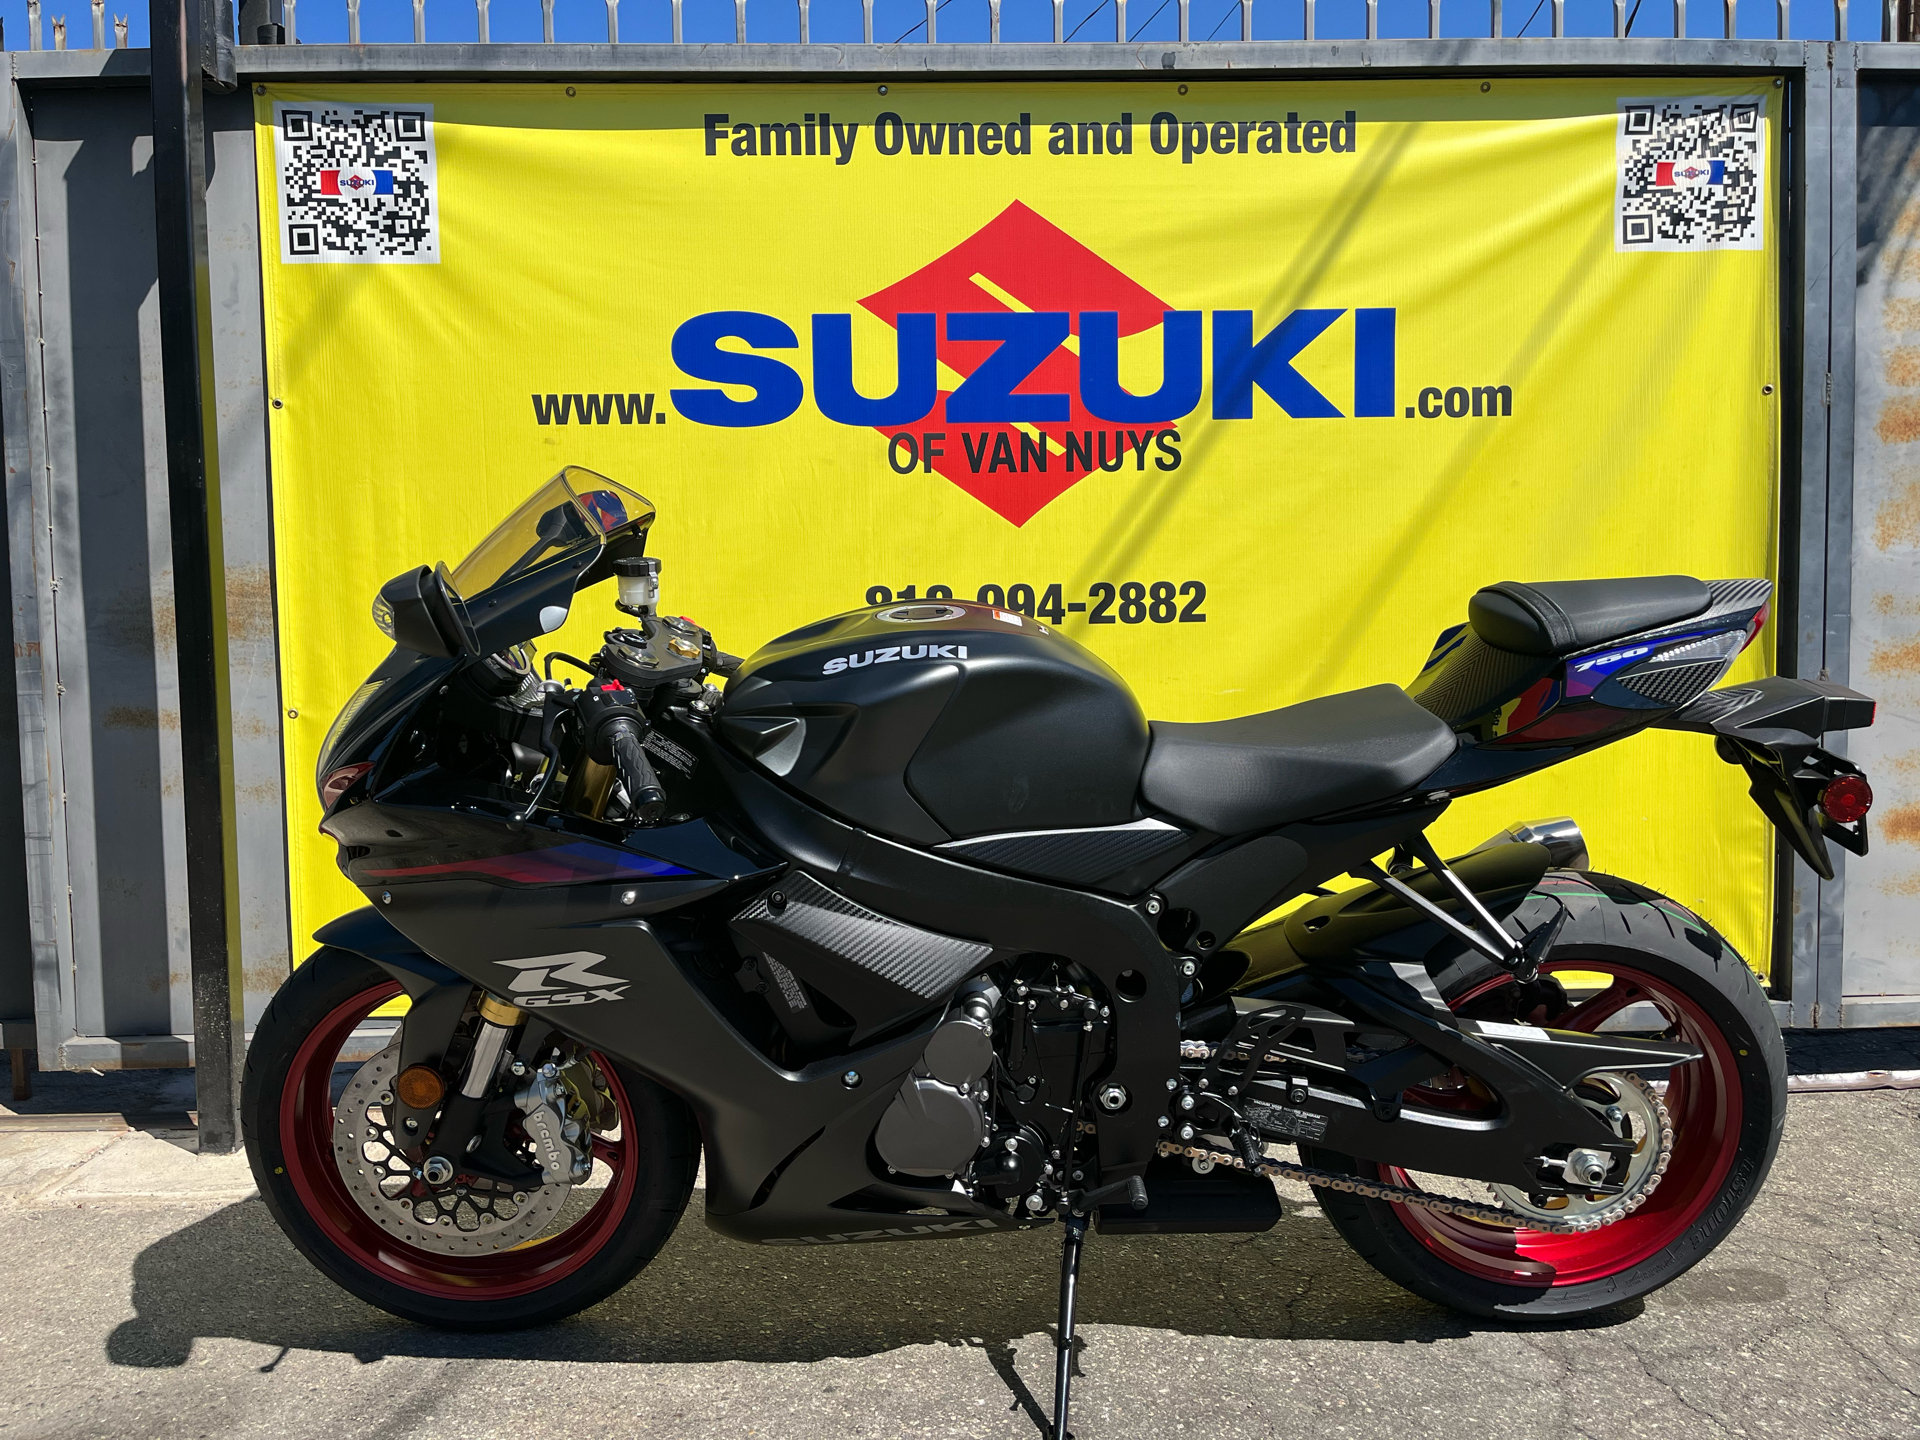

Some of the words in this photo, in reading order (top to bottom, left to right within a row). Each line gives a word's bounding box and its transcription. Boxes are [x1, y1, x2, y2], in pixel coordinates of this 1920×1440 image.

[704, 112, 859, 164] Family
[874, 112, 1031, 156] Owned
[1048, 112, 1133, 155] and
[1149, 111, 1357, 164] Operated
[339, 179, 375, 187] SUZUKI
[1674, 169, 1710, 178] SUZUKI
[532, 393, 666, 425] www.
[670, 307, 1396, 427] SUZUKI
[1405, 385, 1512, 419] .com
[888, 433, 946, 475] OF
[962, 432, 1047, 474] VAN
[1067, 429, 1182, 473] NUYS
[865, 580, 1207, 625] 8994-2882
[822, 645, 968, 675] SUZUKI
[1575, 647, 1648, 672] 750
[513, 984, 632, 1007] GSX
[533, 1110, 560, 1170] brembo
